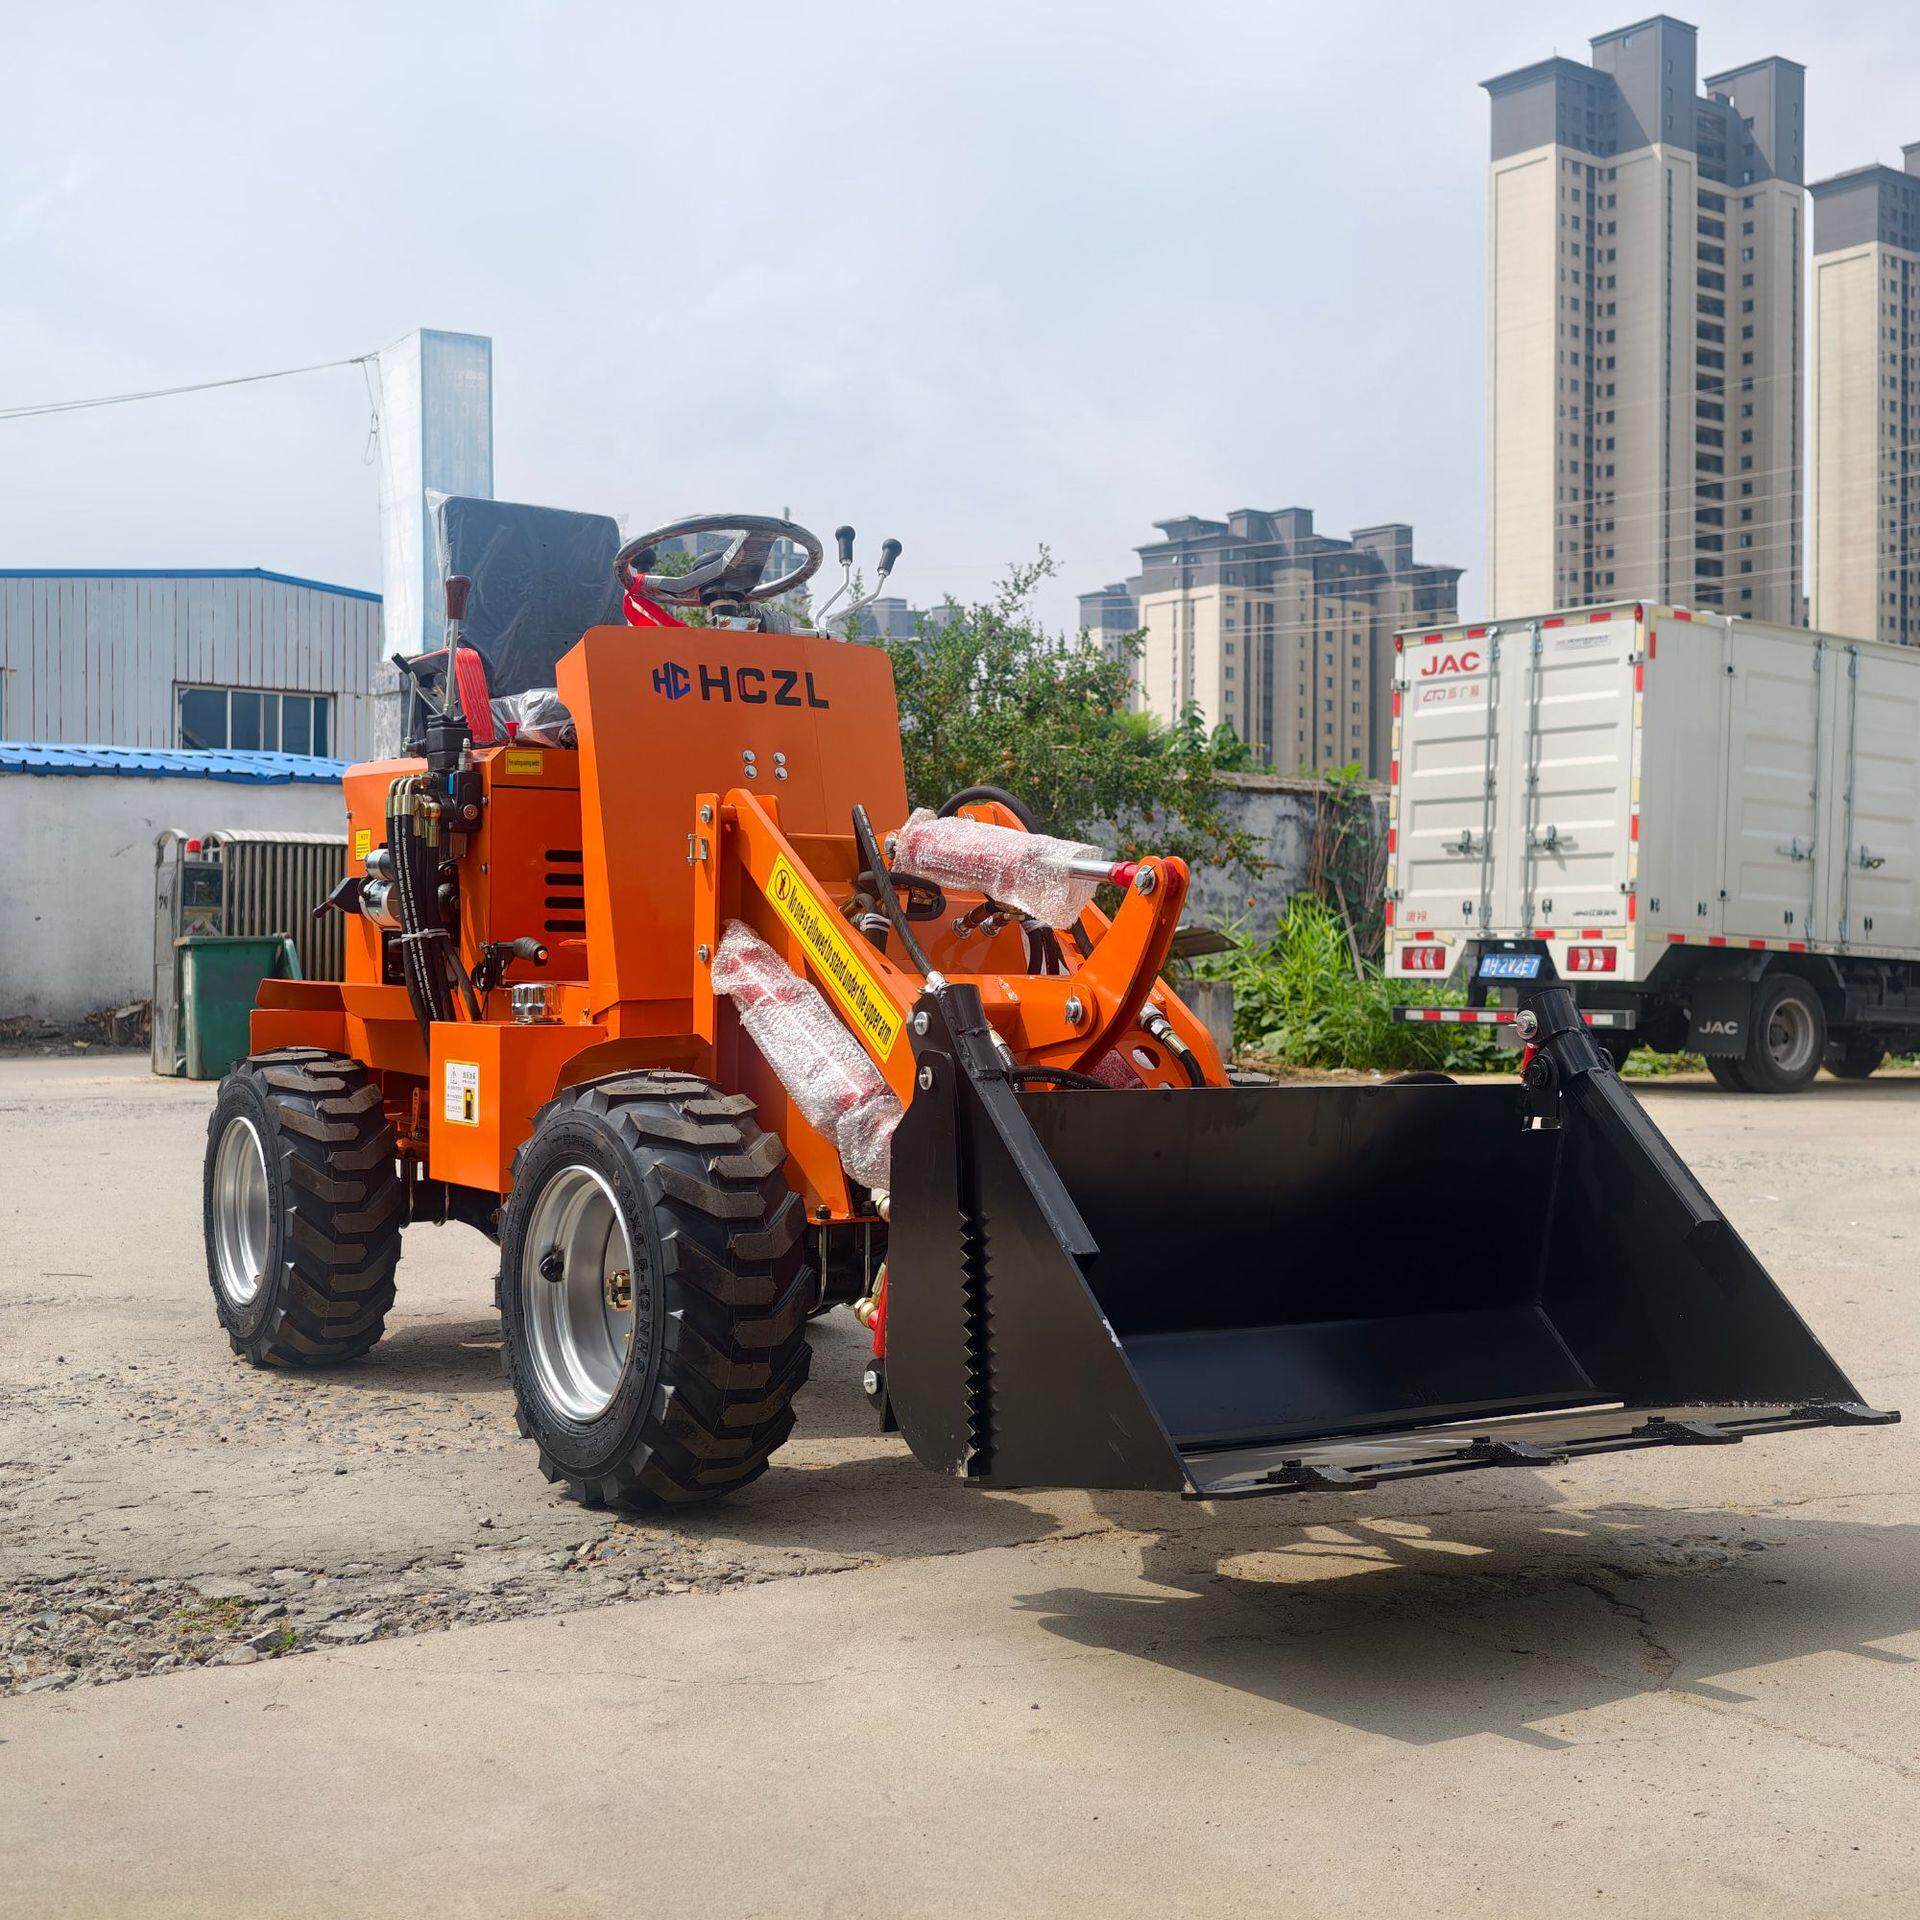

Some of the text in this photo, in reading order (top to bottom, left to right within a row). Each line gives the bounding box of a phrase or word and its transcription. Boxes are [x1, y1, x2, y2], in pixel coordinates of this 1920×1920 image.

[1421, 651, 1480, 676] JAC
[699, 664, 830, 709] HCZL
[787, 885, 892, 1045] No one is allowed to stand under the upper arm
[1699, 1021, 1738, 1035] JAC
